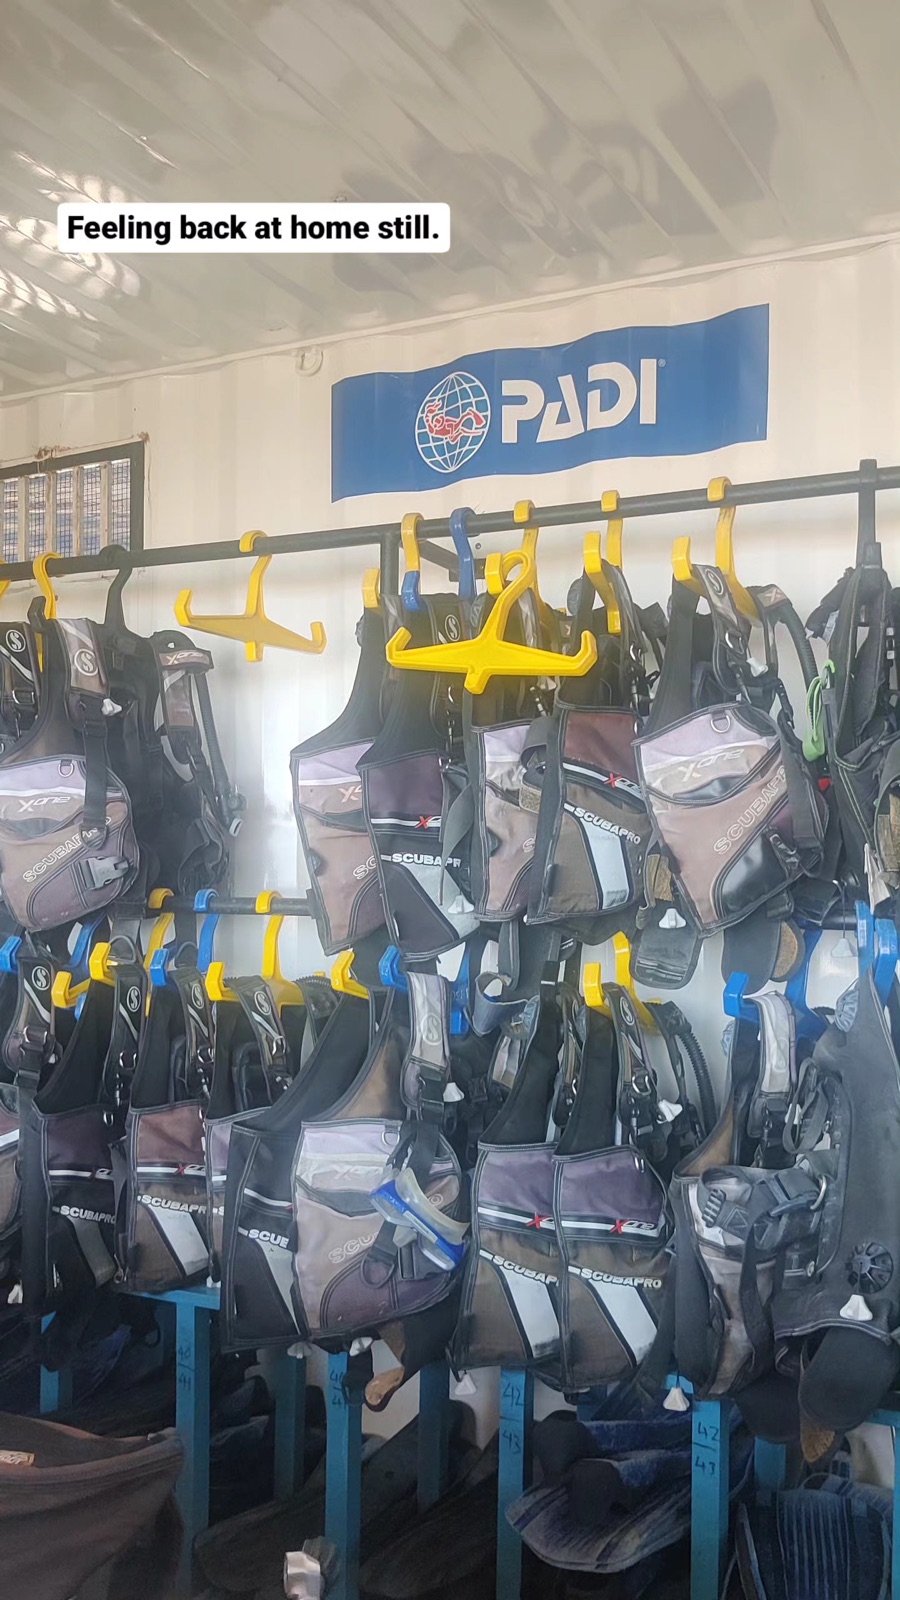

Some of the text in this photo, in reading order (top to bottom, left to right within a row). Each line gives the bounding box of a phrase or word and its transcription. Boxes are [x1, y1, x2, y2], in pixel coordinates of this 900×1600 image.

[501, 358, 657, 444] PADI
[573, 806, 642, 846] SCUBAPRO
[492, 1254, 559, 1288] SCUBAP
[580, 1267, 663, 1290] SCUBAPRO
[503, 1381, 525, 1408] 42
[697, 1421, 720, 1441] 42
[694, 1455, 716, 1476] 43
